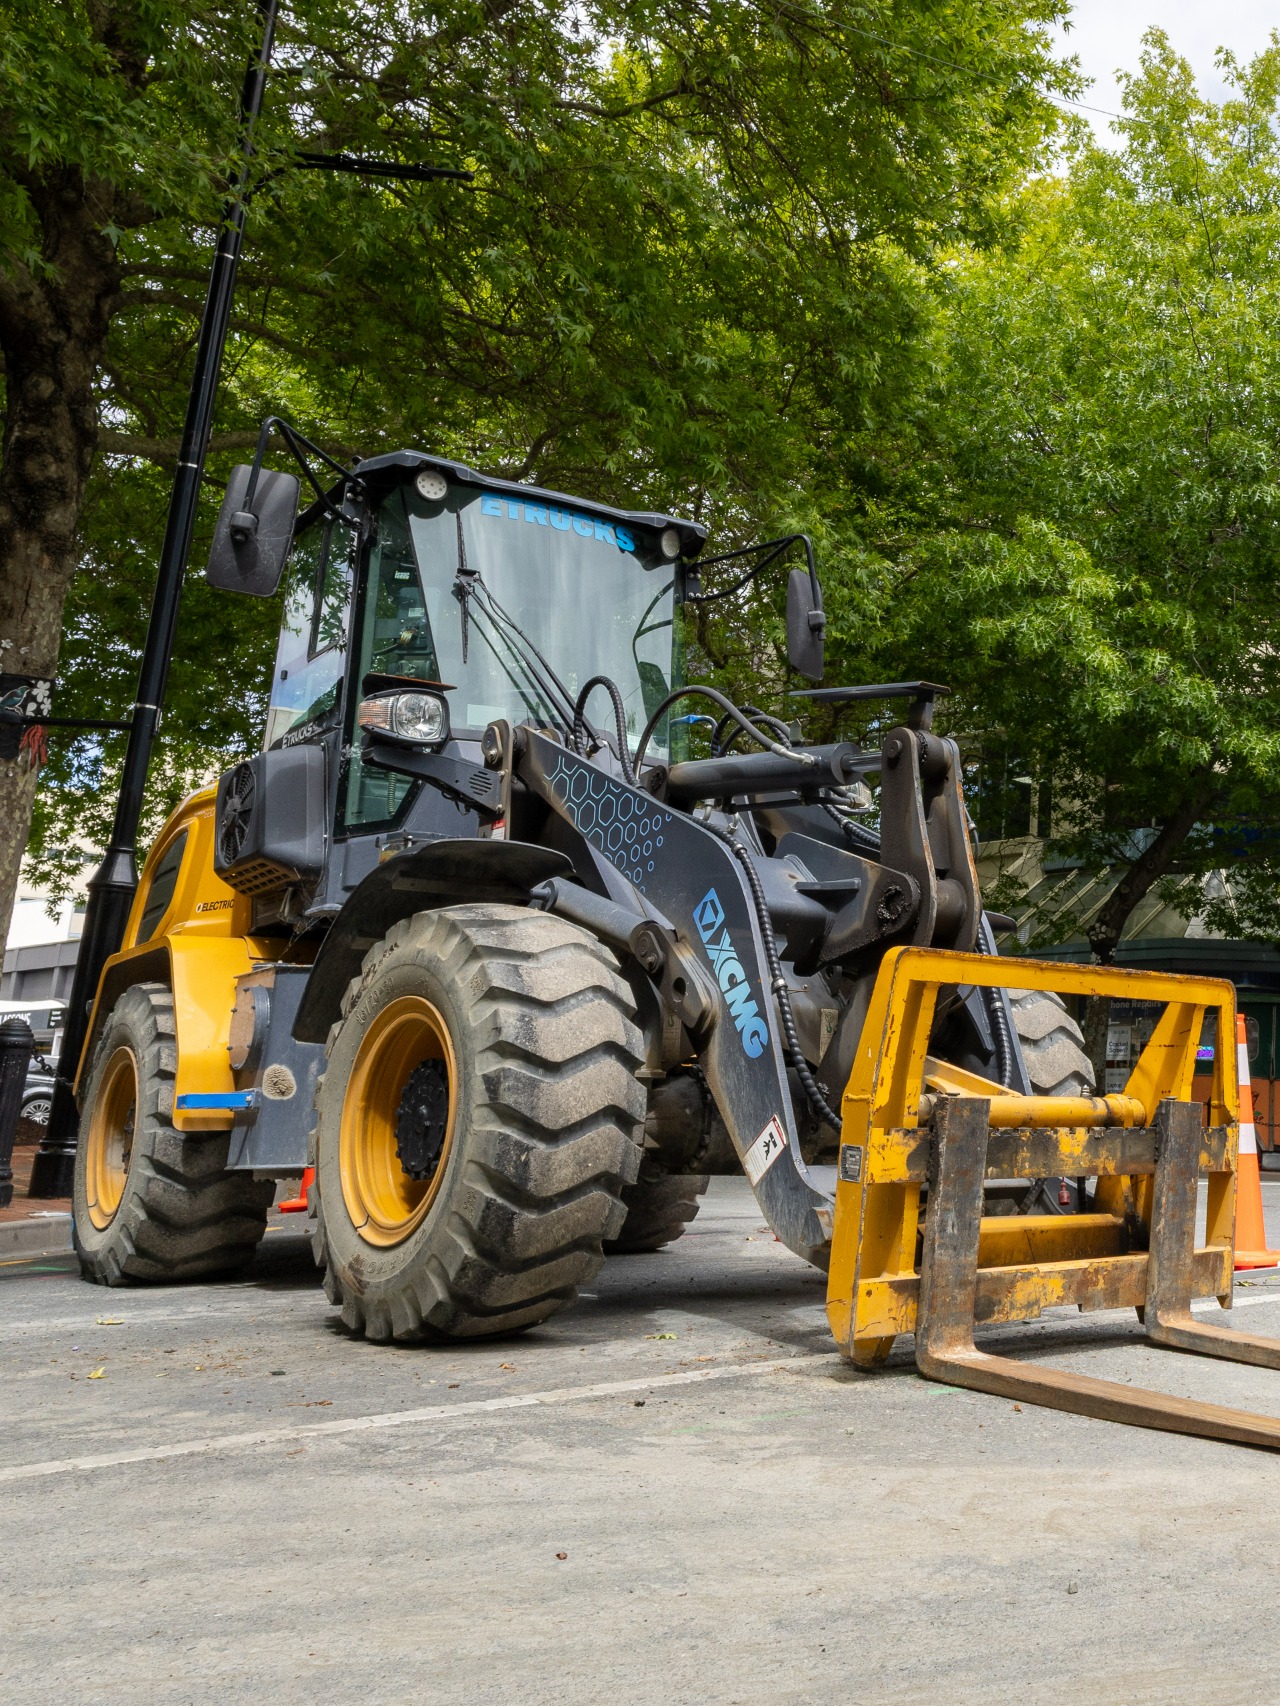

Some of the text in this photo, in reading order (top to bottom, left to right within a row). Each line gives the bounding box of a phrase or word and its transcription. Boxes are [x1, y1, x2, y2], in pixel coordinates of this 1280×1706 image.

[481, 491, 636, 552] ETRUCKS
[281, 722, 314, 750] ETRUCKS
[201, 898, 235, 912] ELECTRIC
[704, 927, 769, 1059] XCMG
[1110, 1000, 1162, 1010] hone Repairs
